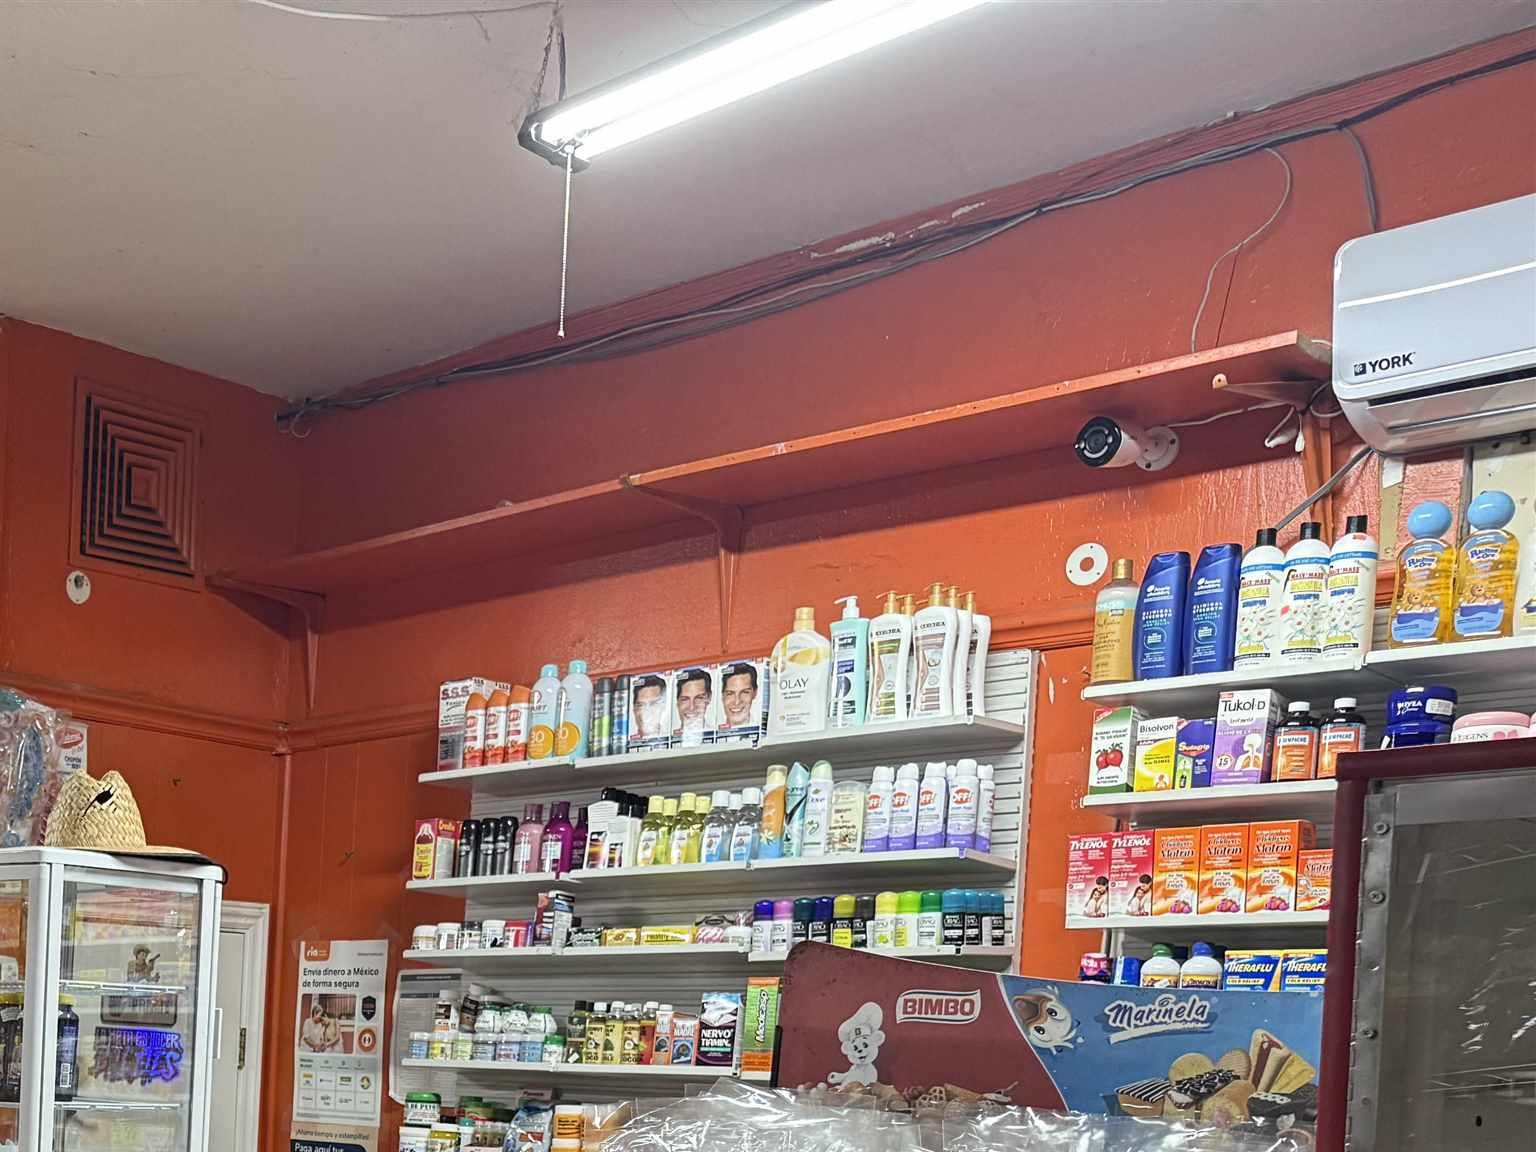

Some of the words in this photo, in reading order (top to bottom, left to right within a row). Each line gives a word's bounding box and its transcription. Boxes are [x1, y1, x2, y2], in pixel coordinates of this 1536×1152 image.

[1367, 353, 1414, 375] YORK
[780, 678, 809, 690] OLAY
[1140, 724, 1174, 733] Bisolvon
[1070, 840, 1108, 851] TYLENOL
[1112, 837, 1152, 849] TYLENOL
[1227, 961, 1273, 974] THERAFLU
[1287, 960, 1327, 973] THERAFL
[334, 981, 359, 989] segura
[903, 998, 976, 1016] BIMBO
[1106, 995, 1210, 1029] Marinela
[701, 1029, 730, 1038] NERVO
